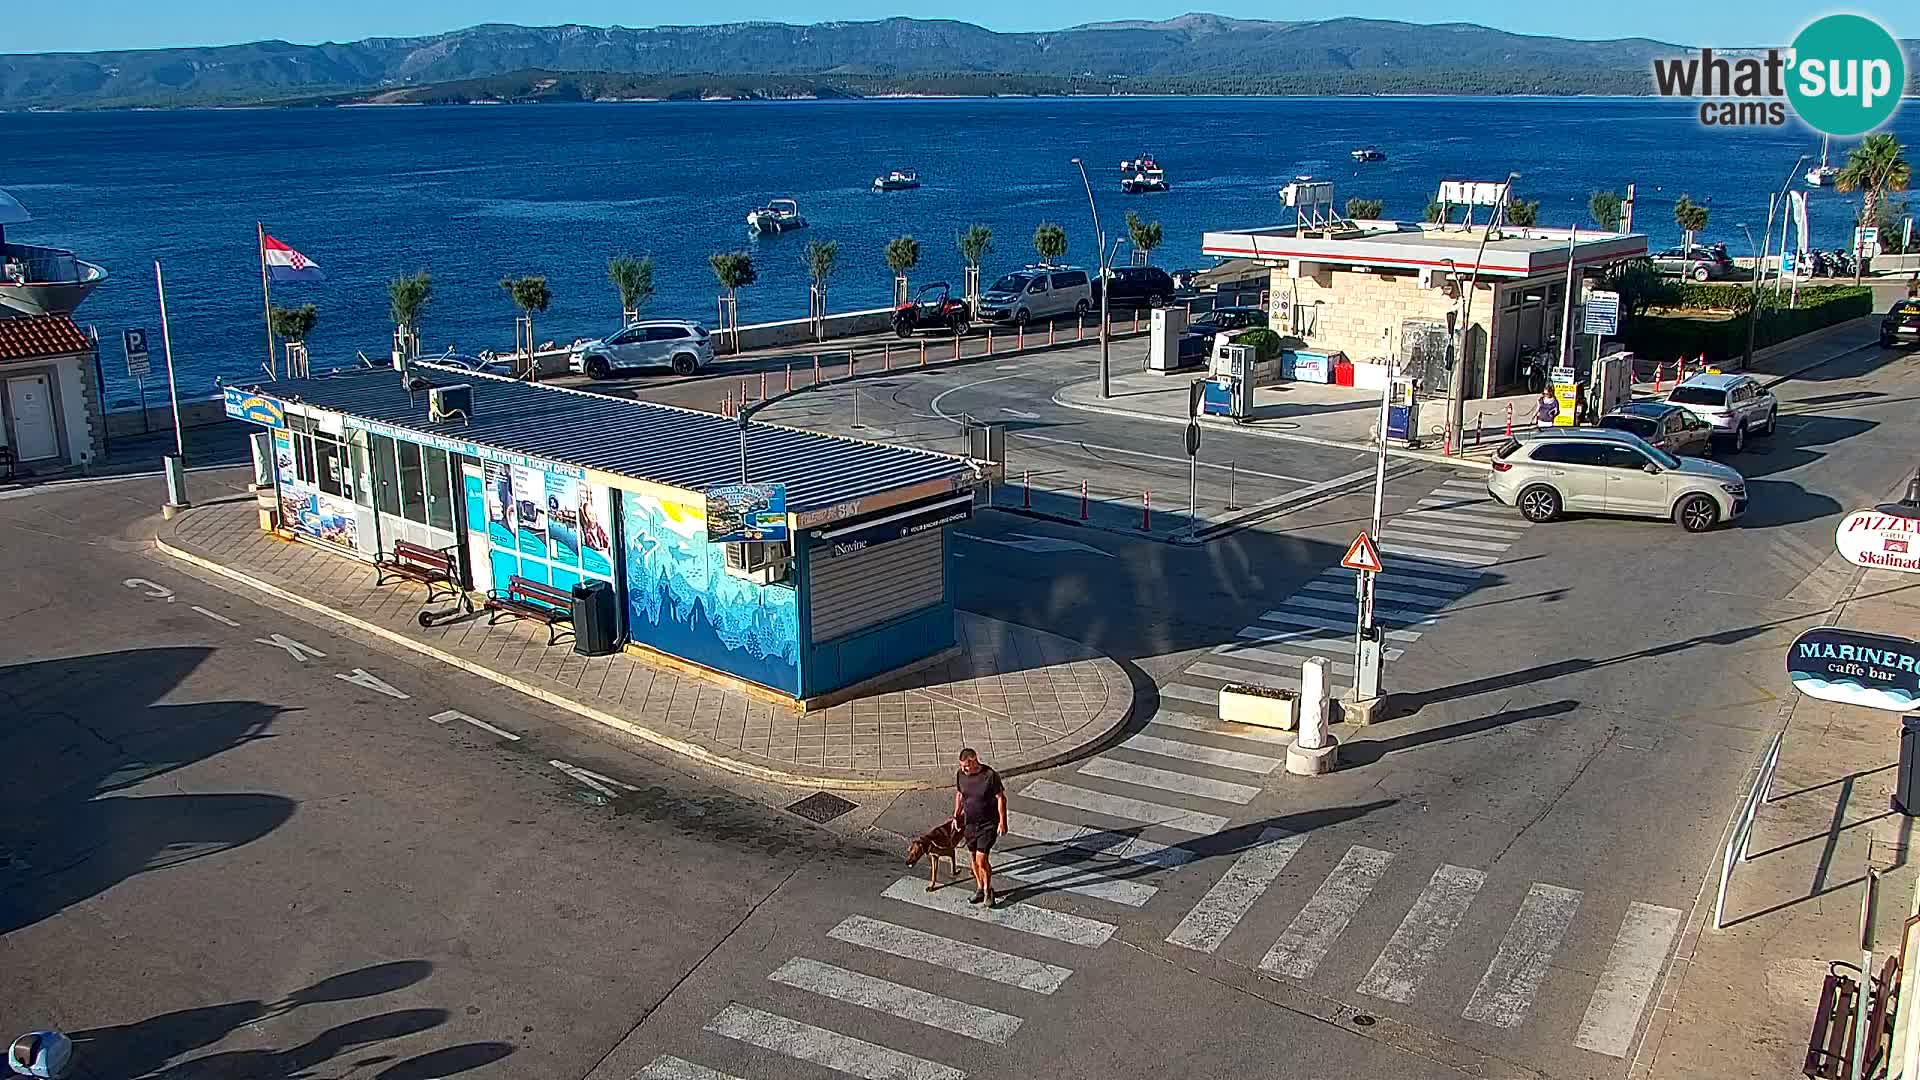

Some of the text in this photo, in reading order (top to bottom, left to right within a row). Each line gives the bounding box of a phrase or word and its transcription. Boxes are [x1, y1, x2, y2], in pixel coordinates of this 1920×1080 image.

[128, 332, 142, 351] P
[492, 450, 526, 466] STATION
[527, 458, 554, 472] TICKET
[554, 464, 582, 478] OFFICE
[1848, 516, 1920, 533] PIZZE
[834, 539, 868, 556] iNovine
[1827, 662, 1896, 681] caffe bar
